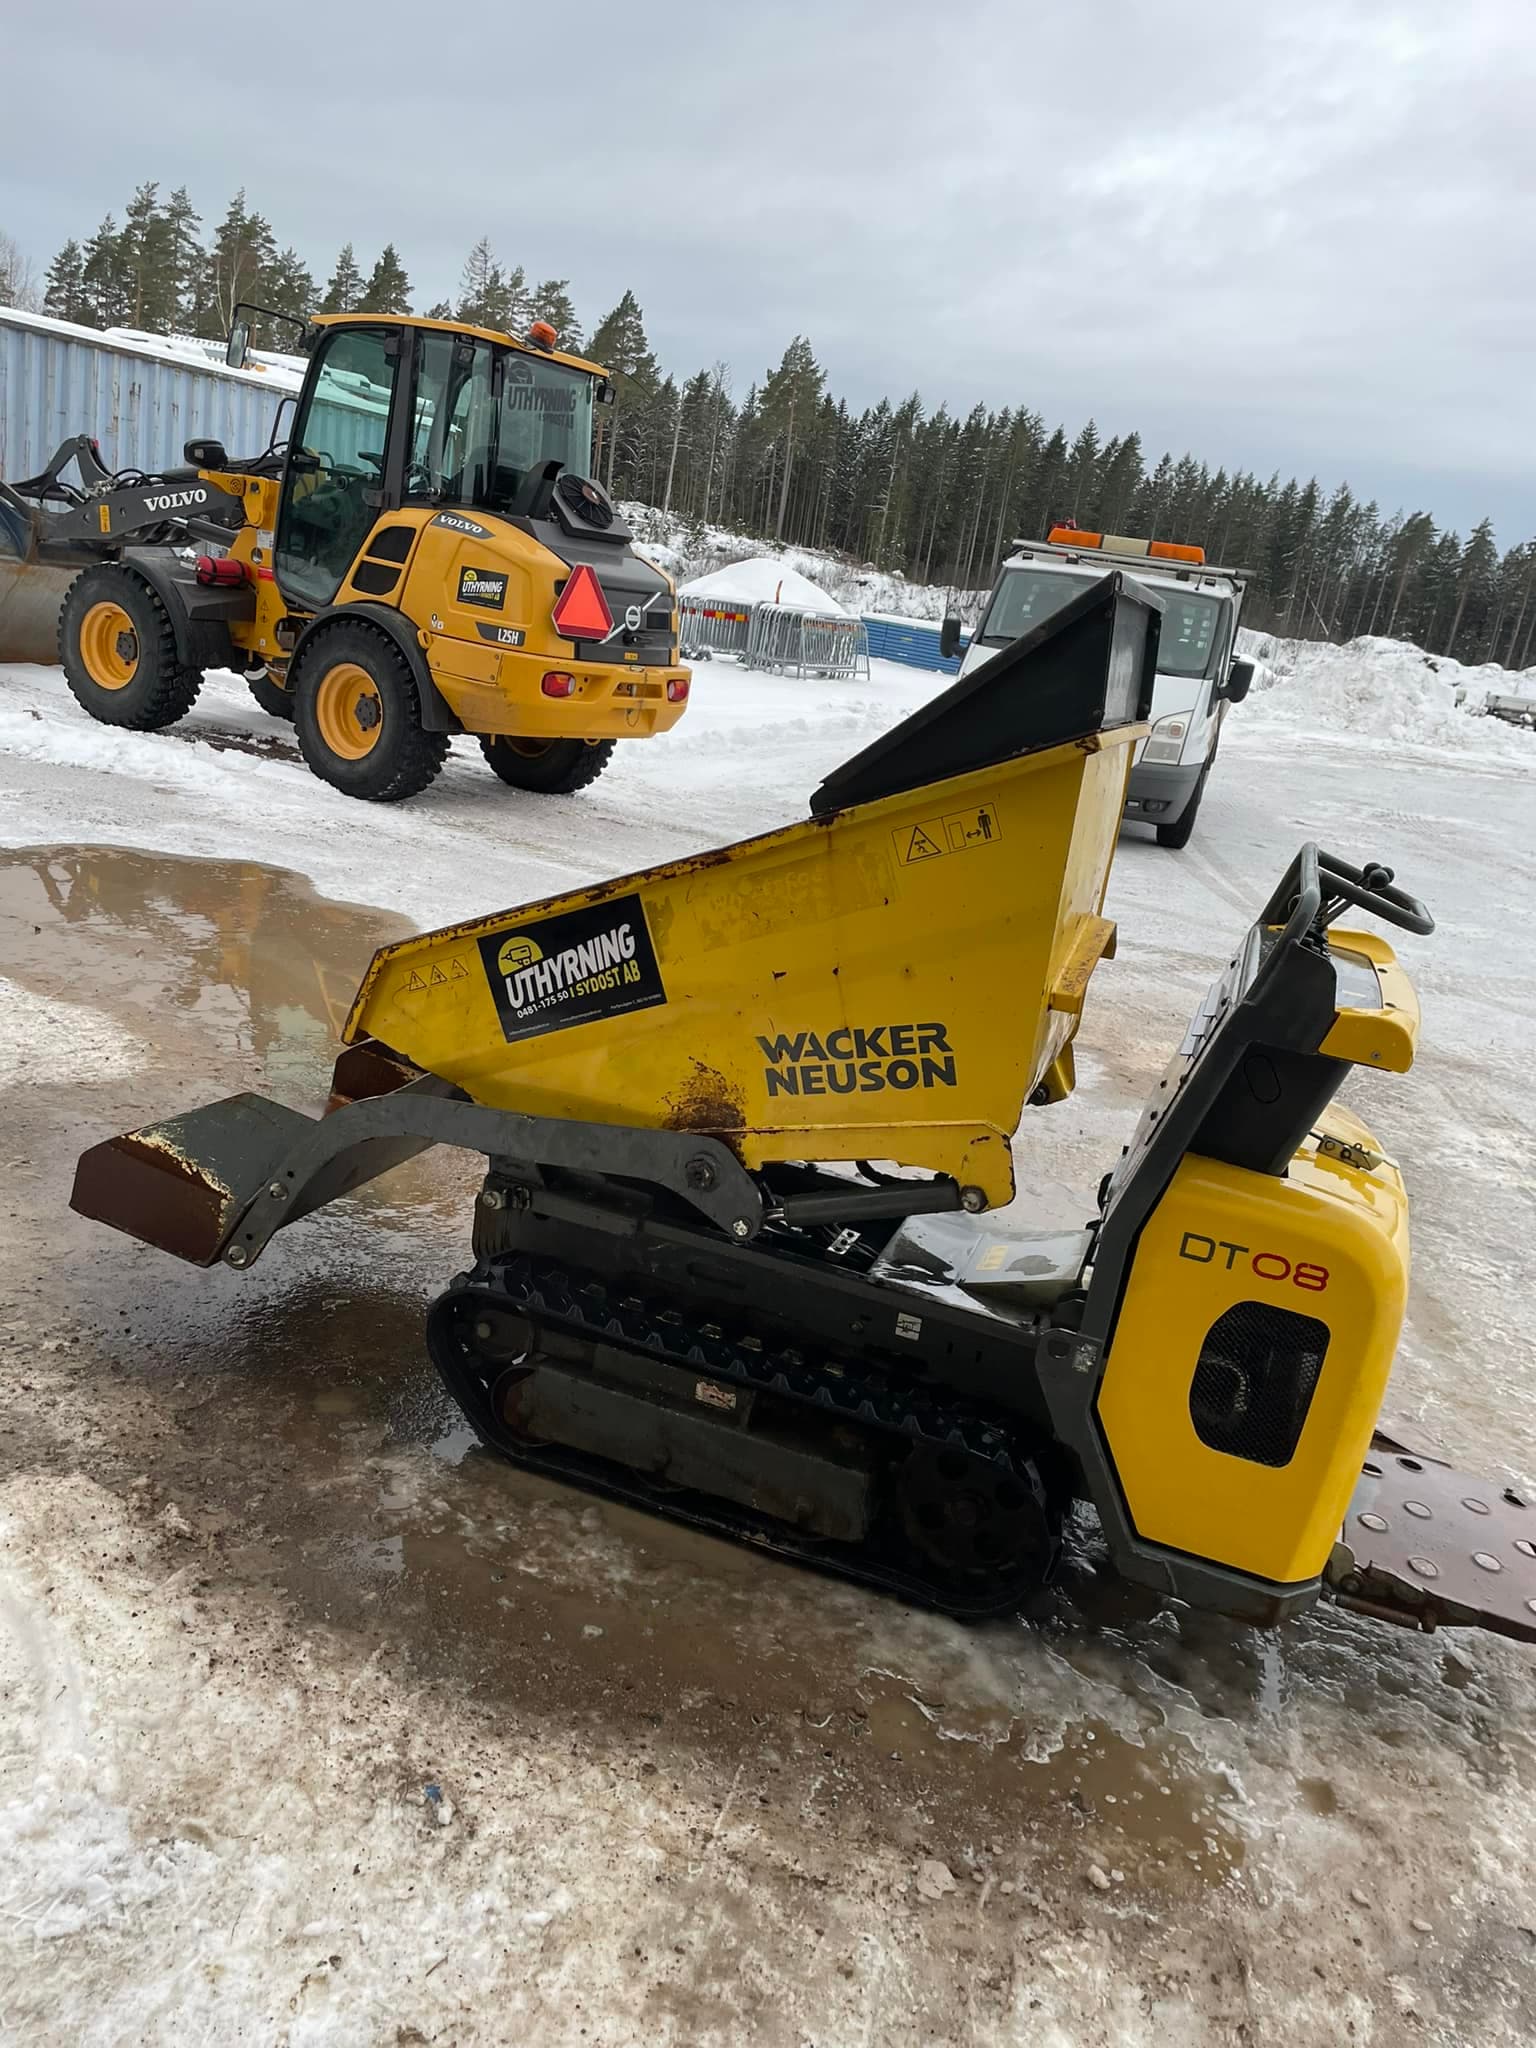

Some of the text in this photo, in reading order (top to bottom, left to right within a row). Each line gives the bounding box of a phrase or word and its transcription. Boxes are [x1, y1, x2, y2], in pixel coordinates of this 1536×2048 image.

[508, 386, 576, 412] UTHYRNING
[143, 488, 207, 512] VOLVO
[440, 515, 483, 534] VOLVO
[462, 581, 503, 593] UTHYRNING
[497, 628, 520, 645] L25H
[505, 923, 636, 1009] UTHYRNING
[576, 966, 621, 997] SYDOST
[623, 959, 641, 984] AB
[516, 995, 557, 1019] 0481-175
[557, 990, 569, 1003] 50
[755, 1022, 954, 1064] WACKER
[765, 1055, 957, 1097] NEUSON
[1179, 1231, 1330, 1292] DT08
